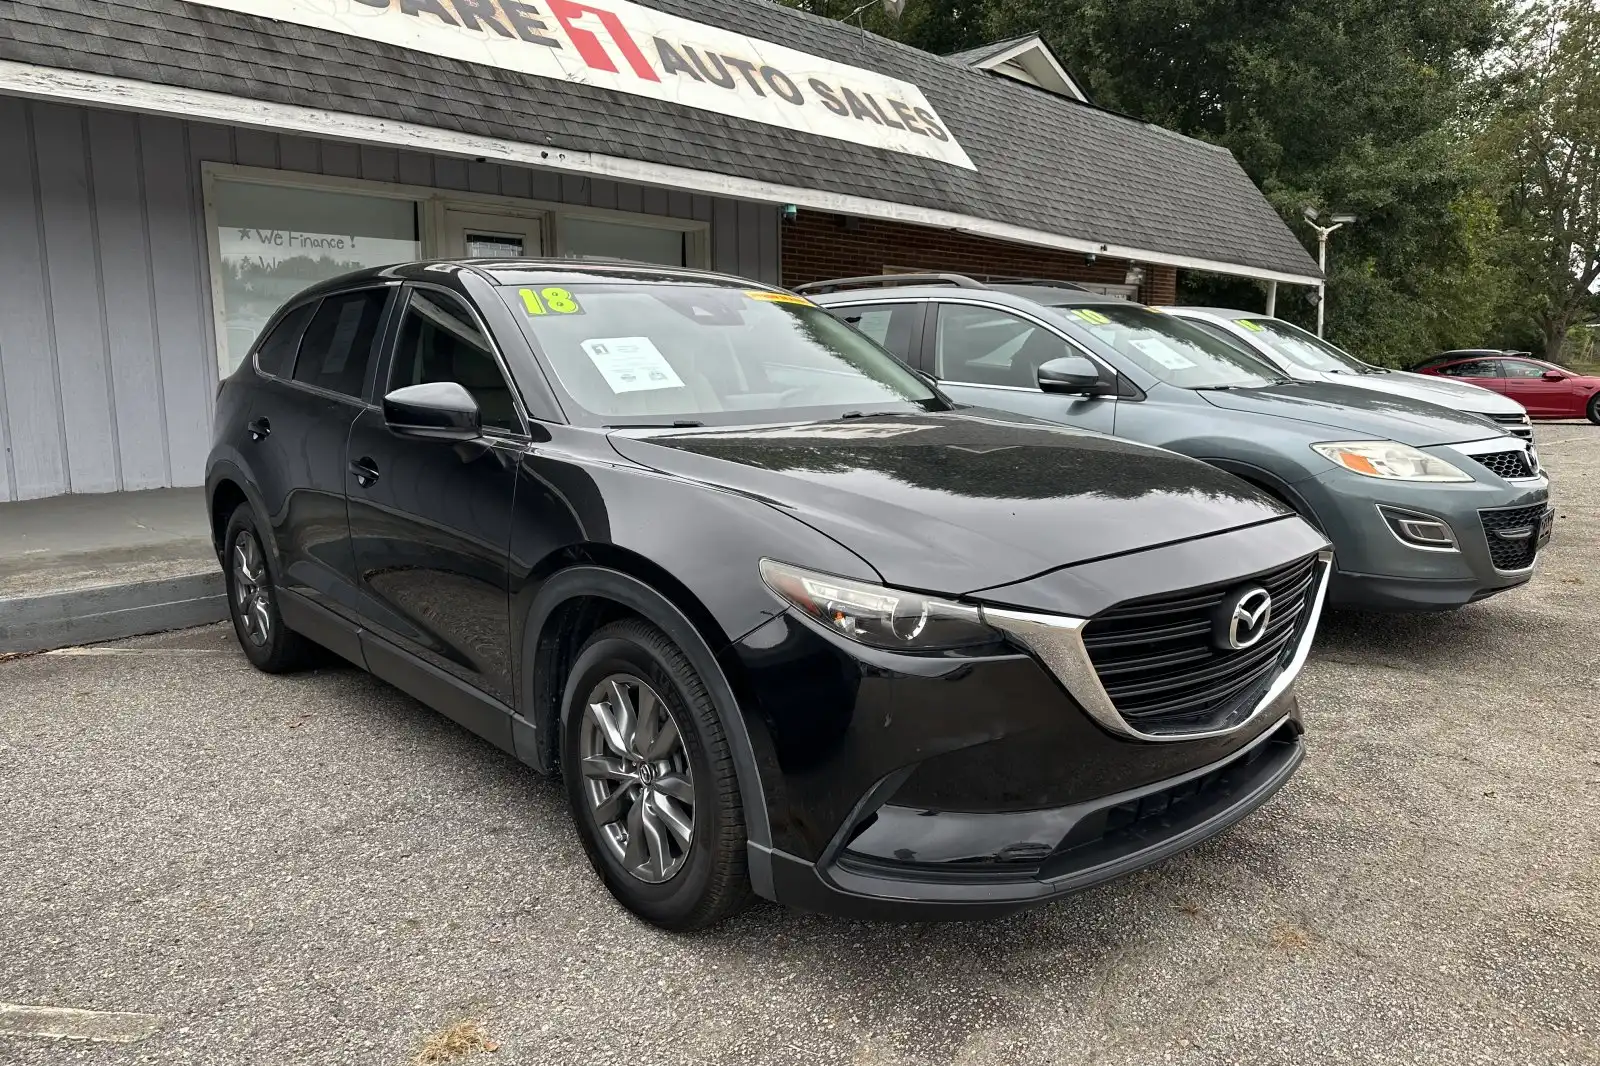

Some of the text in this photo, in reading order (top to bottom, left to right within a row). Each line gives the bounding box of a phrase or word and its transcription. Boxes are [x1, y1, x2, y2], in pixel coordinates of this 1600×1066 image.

[354, 0, 564, 50] ARE
[652, 36, 805, 106] AUTO
[807, 77, 949, 143] SALES
[256, 229, 283, 246] We
[518, 287, 579, 315] 18
